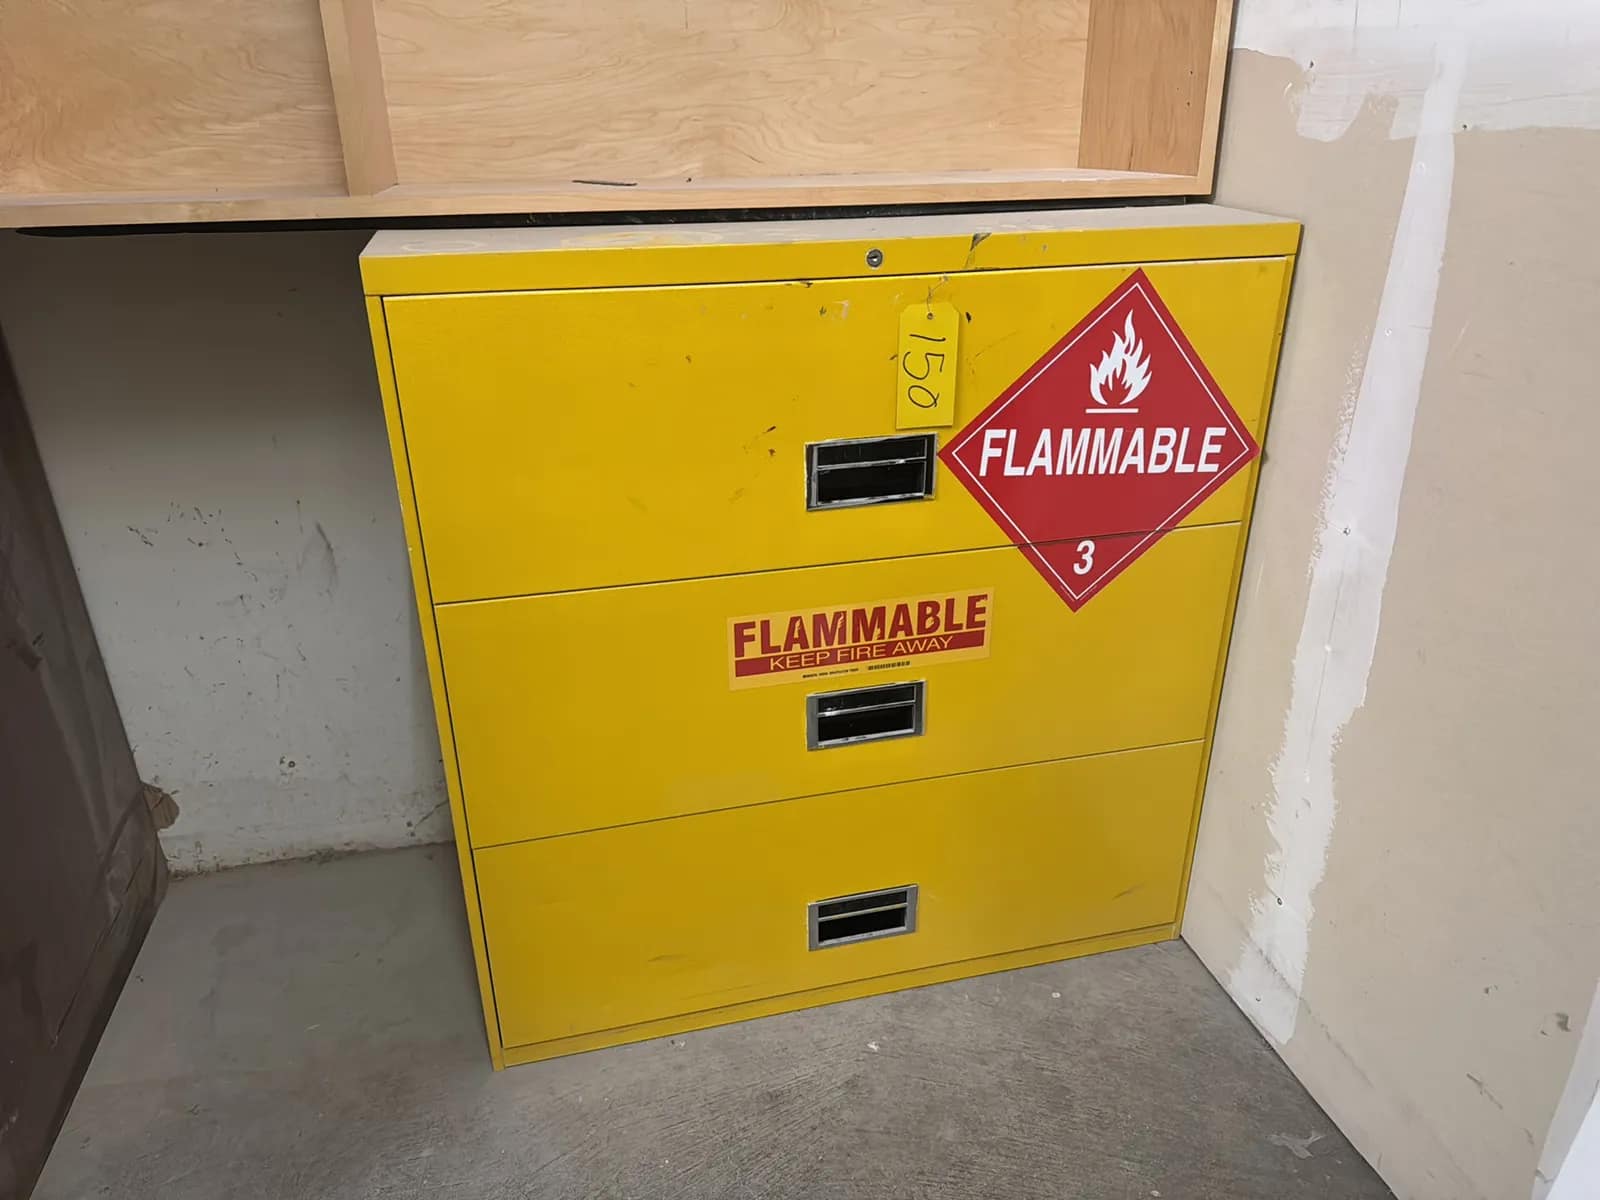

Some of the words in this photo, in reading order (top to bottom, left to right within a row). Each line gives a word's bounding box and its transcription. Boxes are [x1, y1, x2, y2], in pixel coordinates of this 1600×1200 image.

[903, 334, 946, 408] 150
[979, 427, 1227, 477] FLAMMABLE
[1073, 540, 1096, 575] 3
[734, 594, 988, 658] FLAMMABLE
[770, 652, 830, 671] KEEP
[837, 645, 887, 662] FIRE
[892, 636, 953, 655] AWAY
